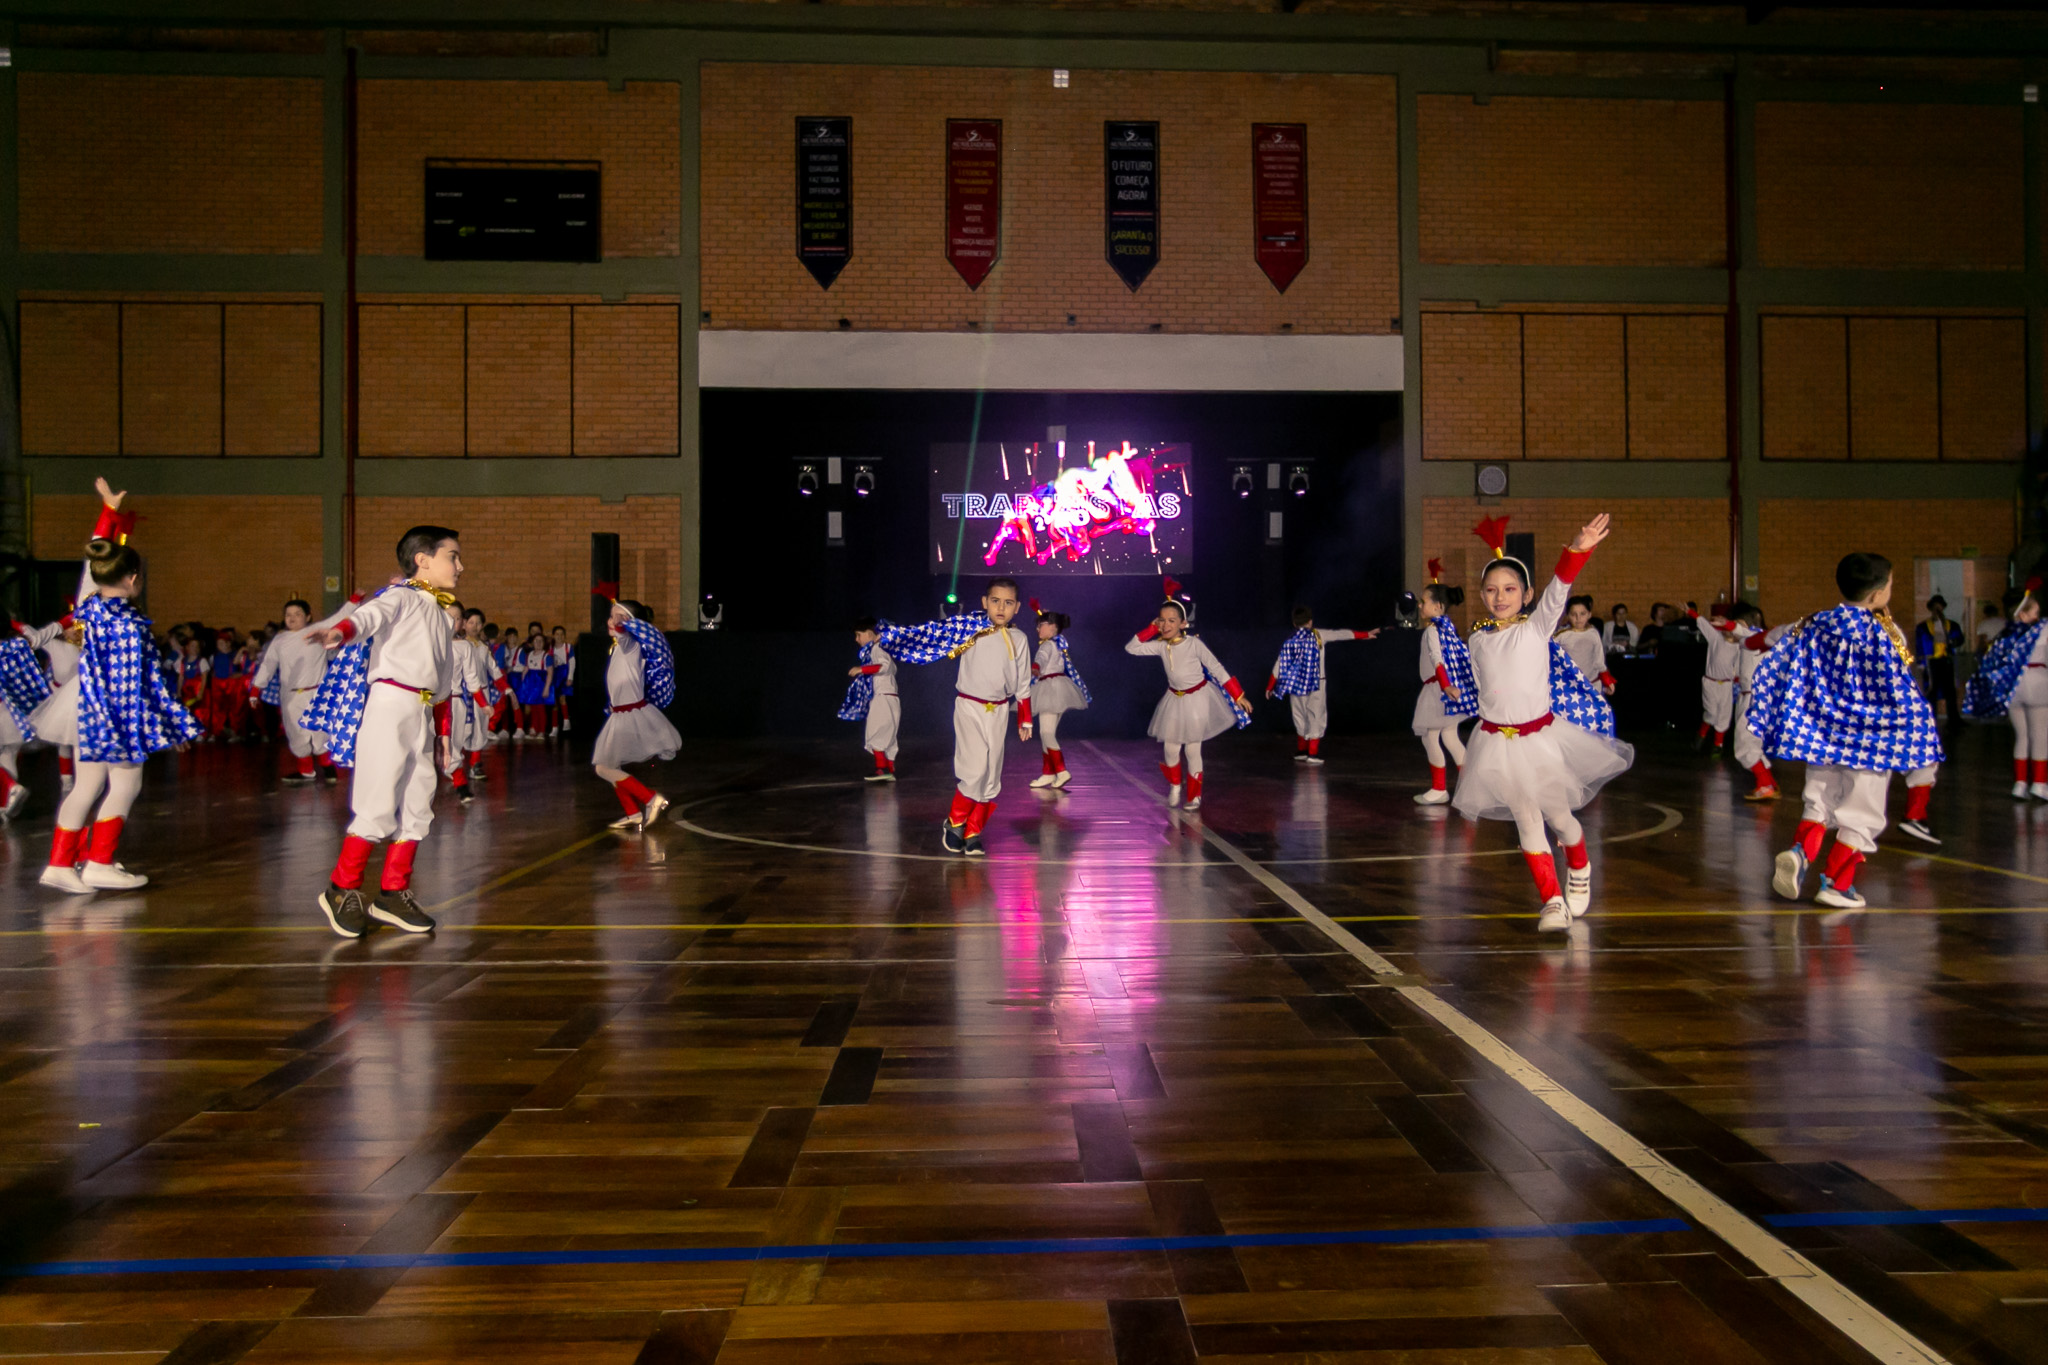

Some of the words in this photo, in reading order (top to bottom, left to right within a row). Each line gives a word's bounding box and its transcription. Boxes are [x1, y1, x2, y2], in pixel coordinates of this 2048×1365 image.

[1111, 160, 1119, 171] O
[1119, 160, 1153, 171] FUTURO
[1115, 175, 1150, 188] COMEÇA
[1111, 230, 1146, 241] GARANTA
[1147, 231, 1154, 242] O
